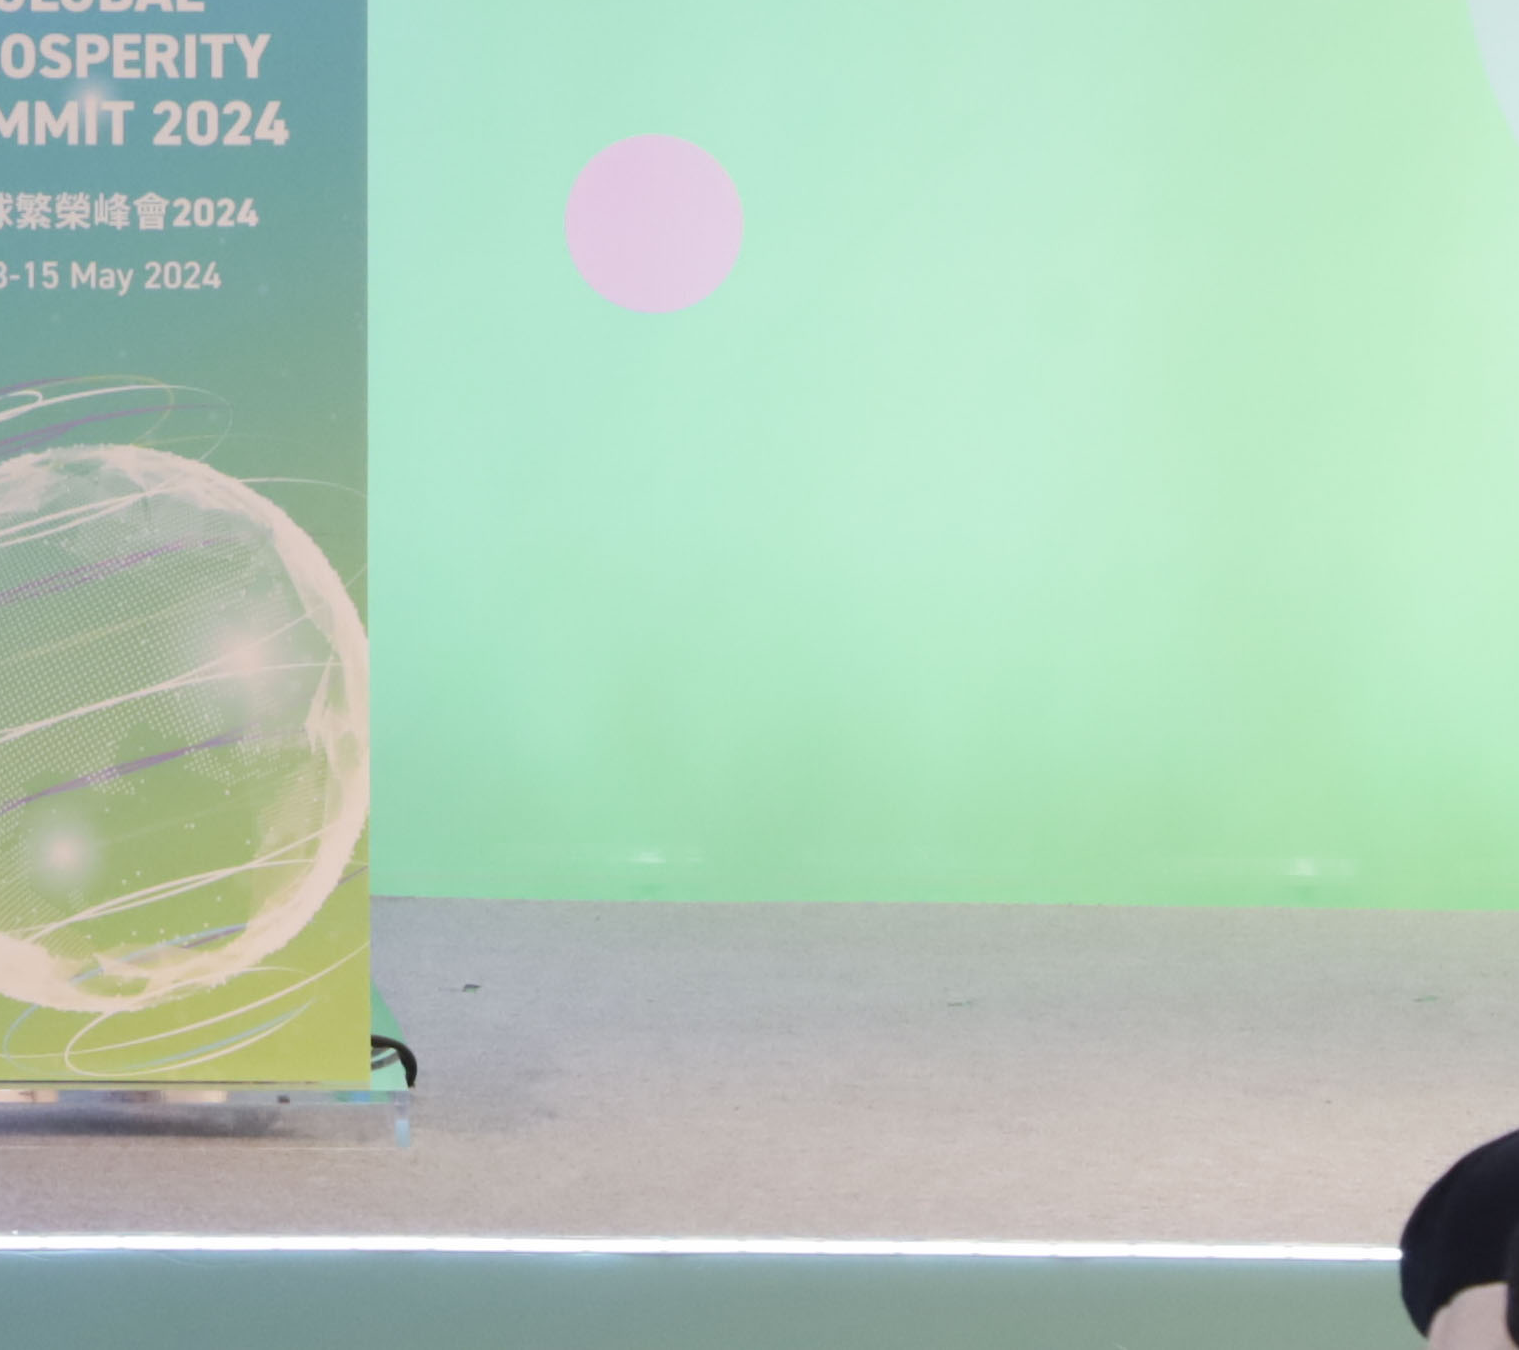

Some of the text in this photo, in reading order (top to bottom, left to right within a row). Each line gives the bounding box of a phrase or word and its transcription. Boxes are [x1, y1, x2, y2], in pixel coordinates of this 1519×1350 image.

[152, 101, 289, 146] 2024
[71, 262, 134, 296] May
[145, 261, 221, 289] 2024
